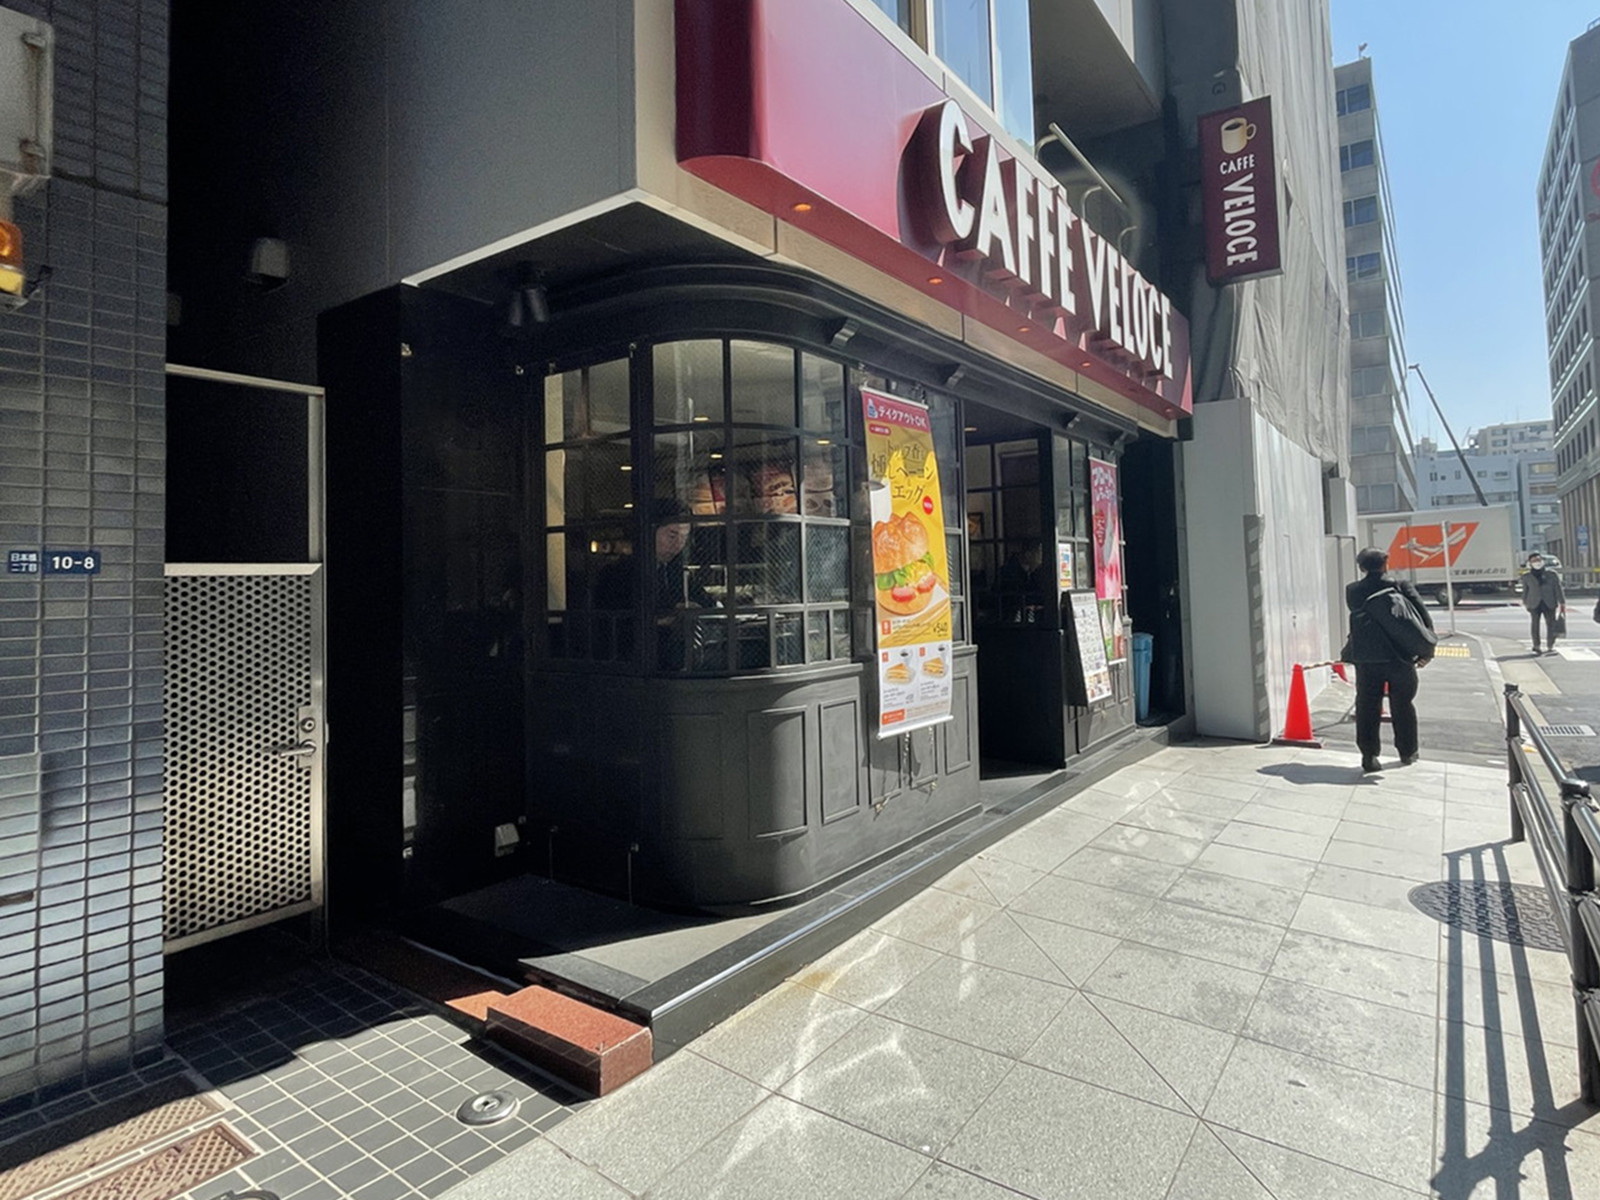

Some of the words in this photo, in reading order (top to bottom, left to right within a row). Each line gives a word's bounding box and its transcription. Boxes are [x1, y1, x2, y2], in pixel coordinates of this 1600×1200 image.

[1223, 172, 1258, 266] VELOCE
[1080, 218, 1173, 380] VELOCE
[52, 556, 95, 569] 10-8
